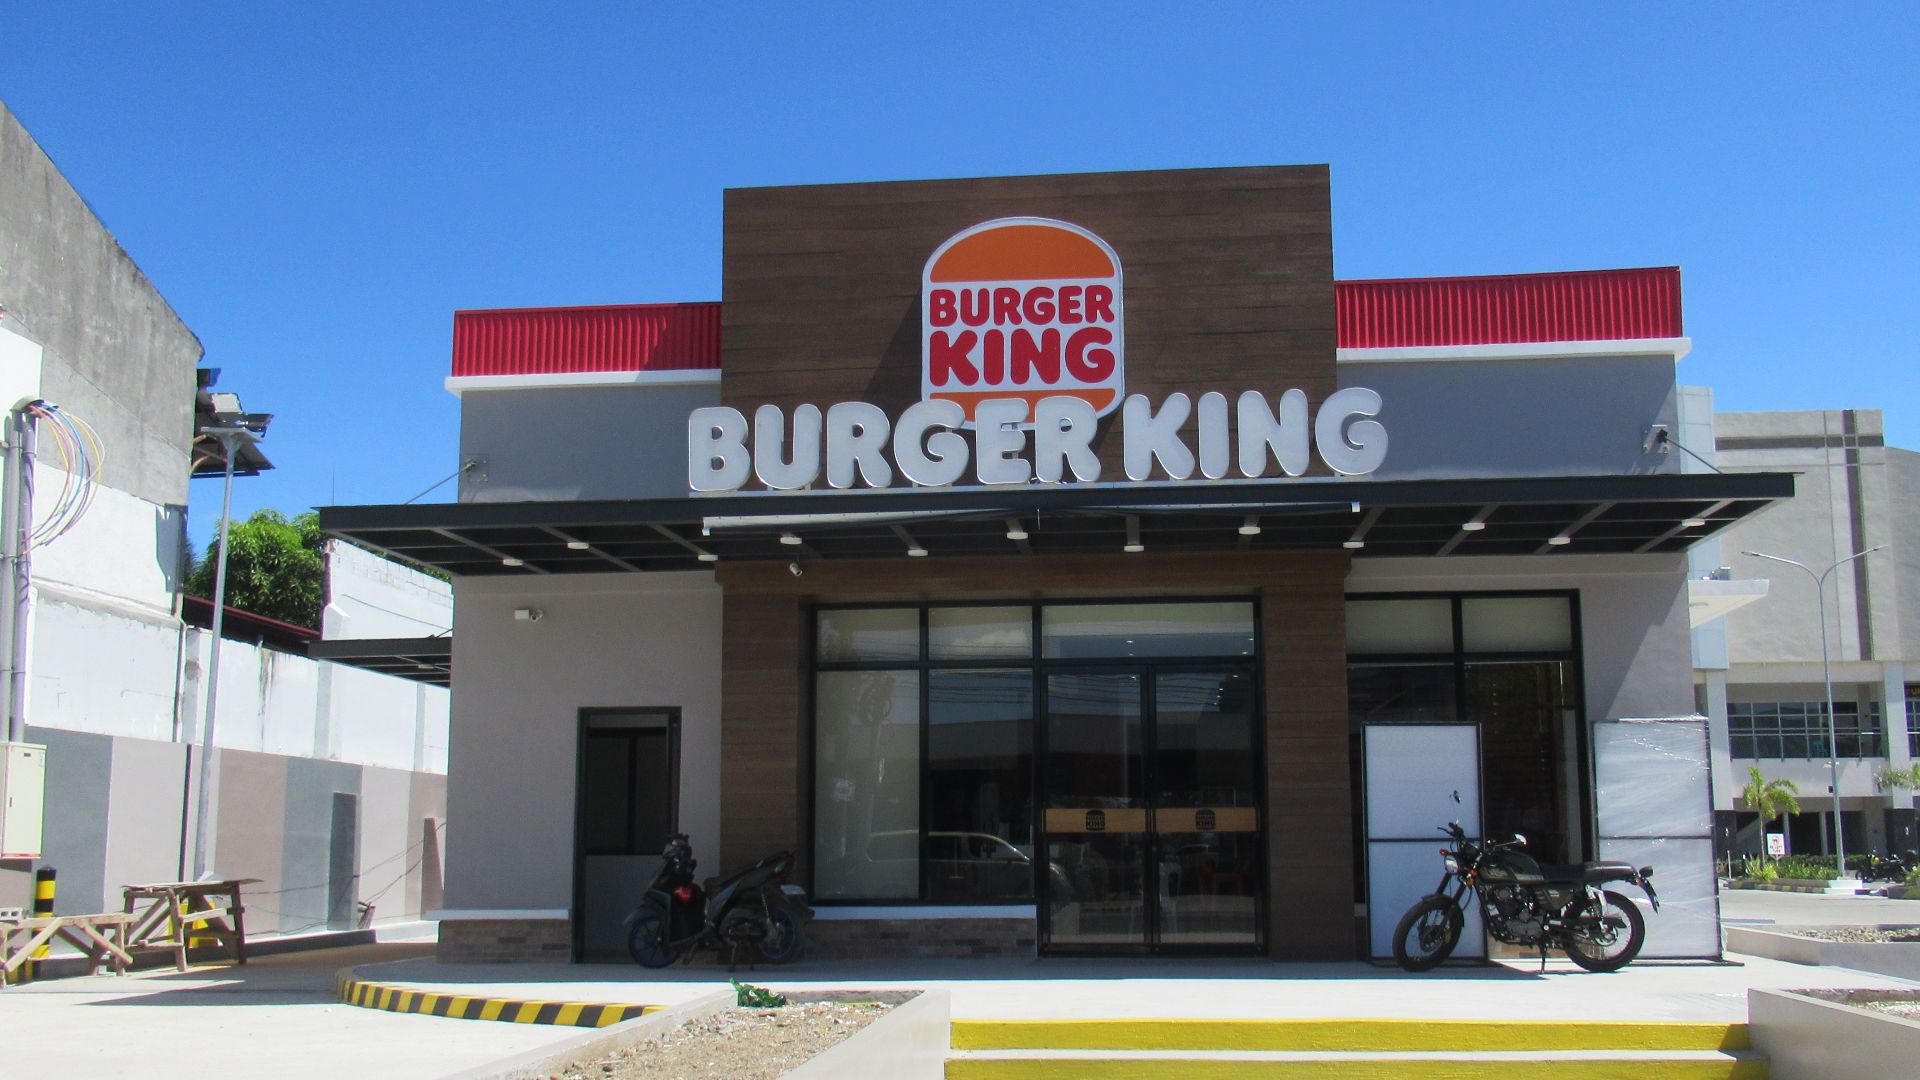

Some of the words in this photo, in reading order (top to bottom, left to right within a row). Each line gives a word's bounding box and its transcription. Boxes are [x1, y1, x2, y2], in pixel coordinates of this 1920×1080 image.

[930, 285, 1115, 327] BURGER
[929, 327, 1116, 386] KING
[688, 396, 1102, 492] BURGER
[1122, 387, 1390, 482] KING
